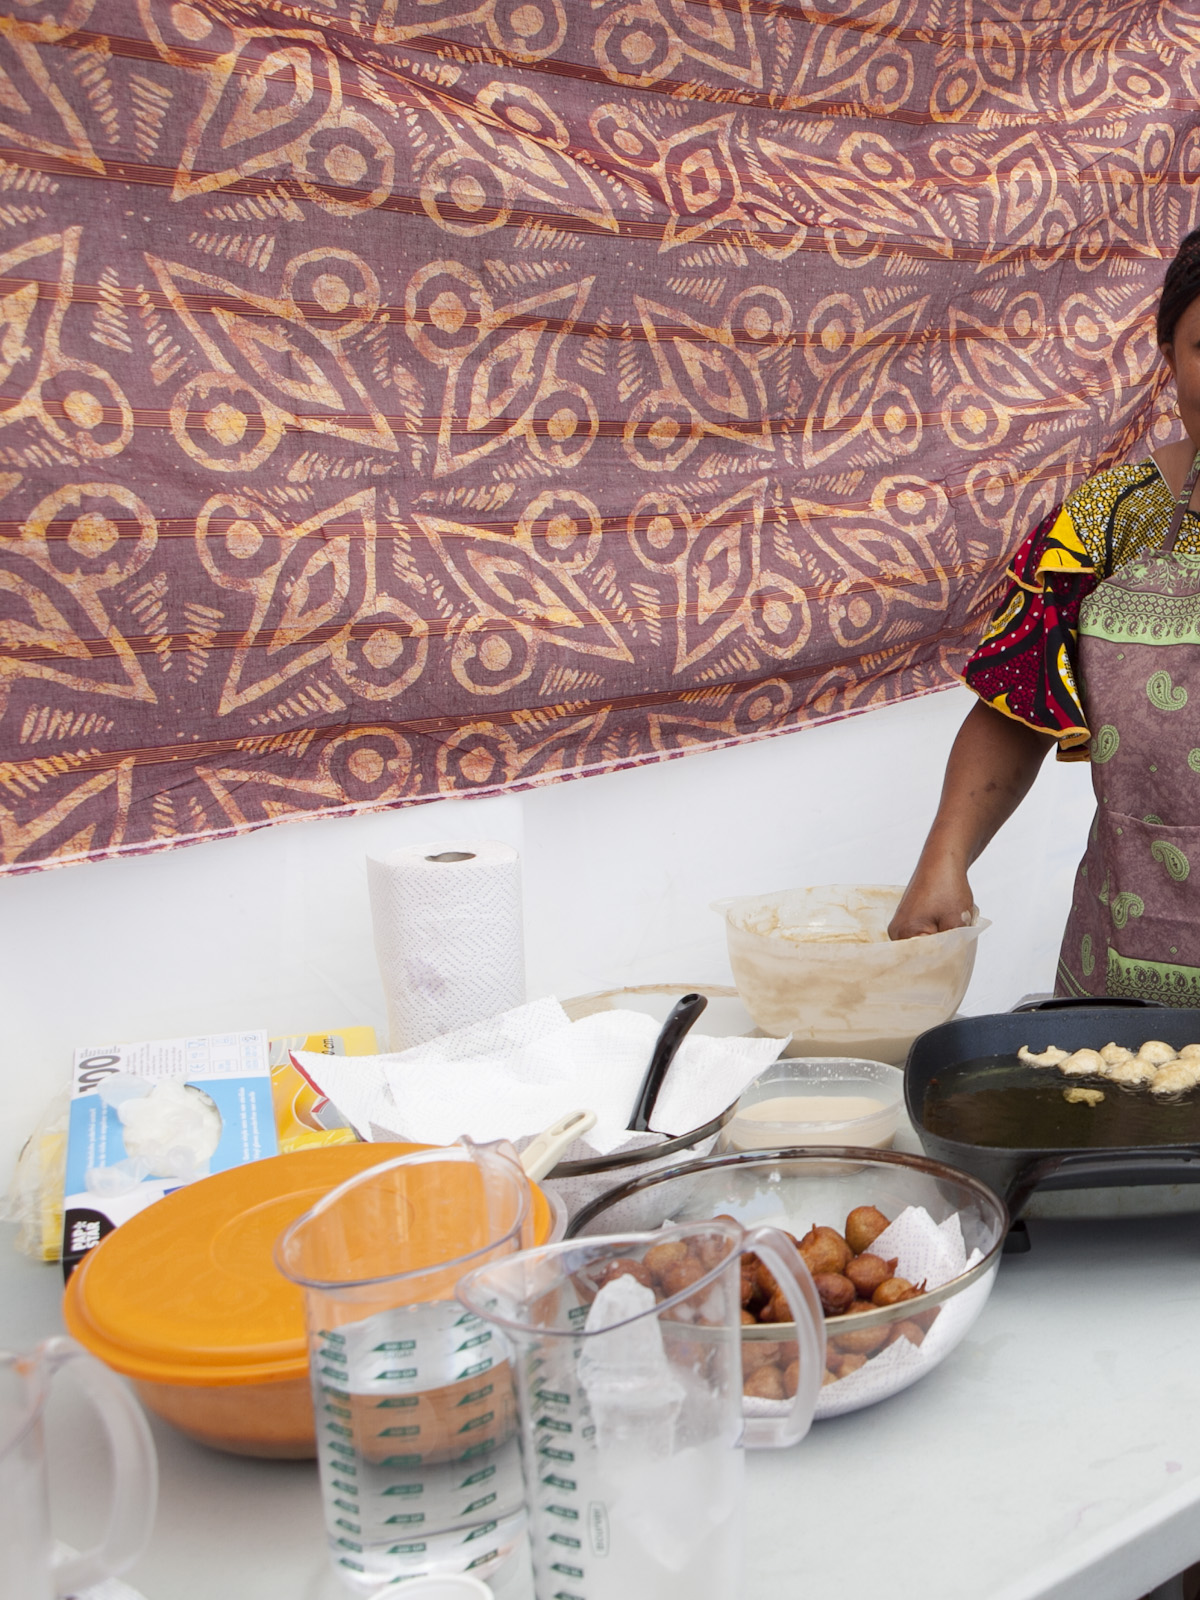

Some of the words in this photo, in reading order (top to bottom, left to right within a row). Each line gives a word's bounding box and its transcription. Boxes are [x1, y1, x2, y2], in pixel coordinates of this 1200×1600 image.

[78, 1055, 121, 1093] 100
[71, 1228, 87, 1252] PAP
[86, 1221, 101, 1249] STAR
